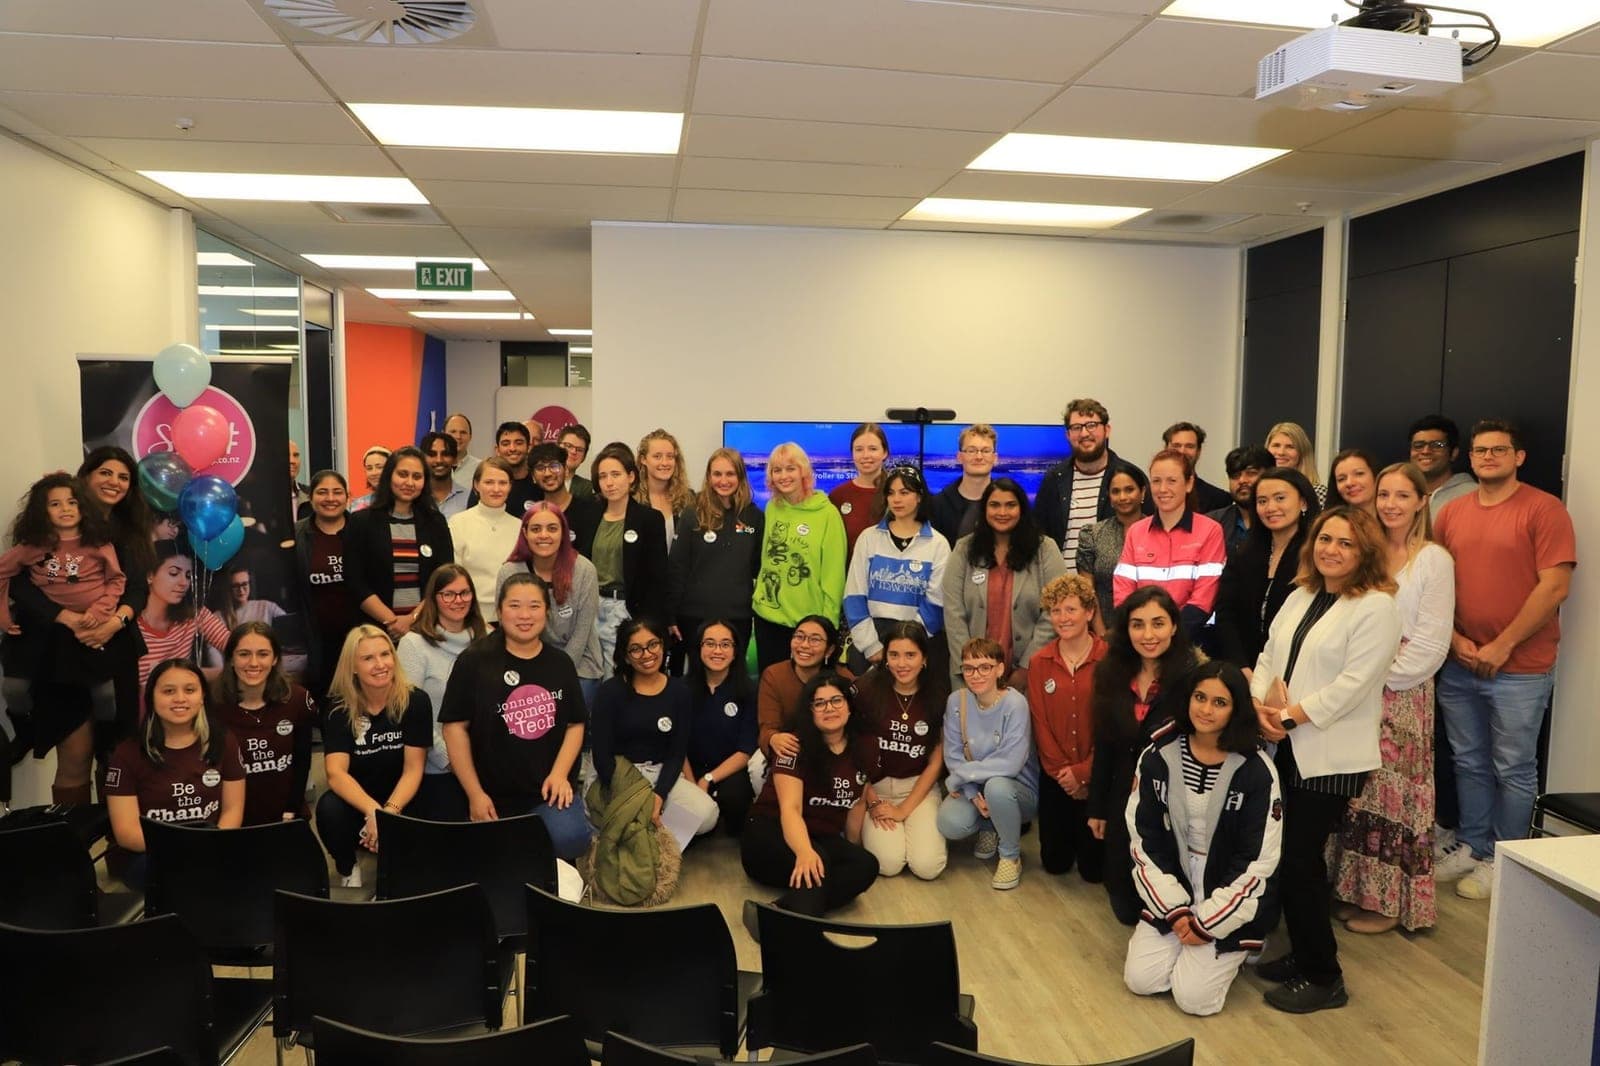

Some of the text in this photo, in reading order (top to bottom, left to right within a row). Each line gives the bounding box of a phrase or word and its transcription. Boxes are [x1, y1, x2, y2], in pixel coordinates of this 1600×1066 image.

[436, 267, 468, 287] EXIT
[309, 572, 345, 585] Cha
[501, 701, 557, 724] women
[515, 714, 556, 736] Tech
[890, 720, 909, 733] Be
[892, 732, 912, 742] the
[246, 738, 268, 751] Be
[878, 736, 926, 759] hange
[252, 750, 275, 761] the
[171, 782, 195, 797] Be
[833, 777, 850, 789] Be
[836, 789, 854, 799] the
[177, 796, 202, 807] the
